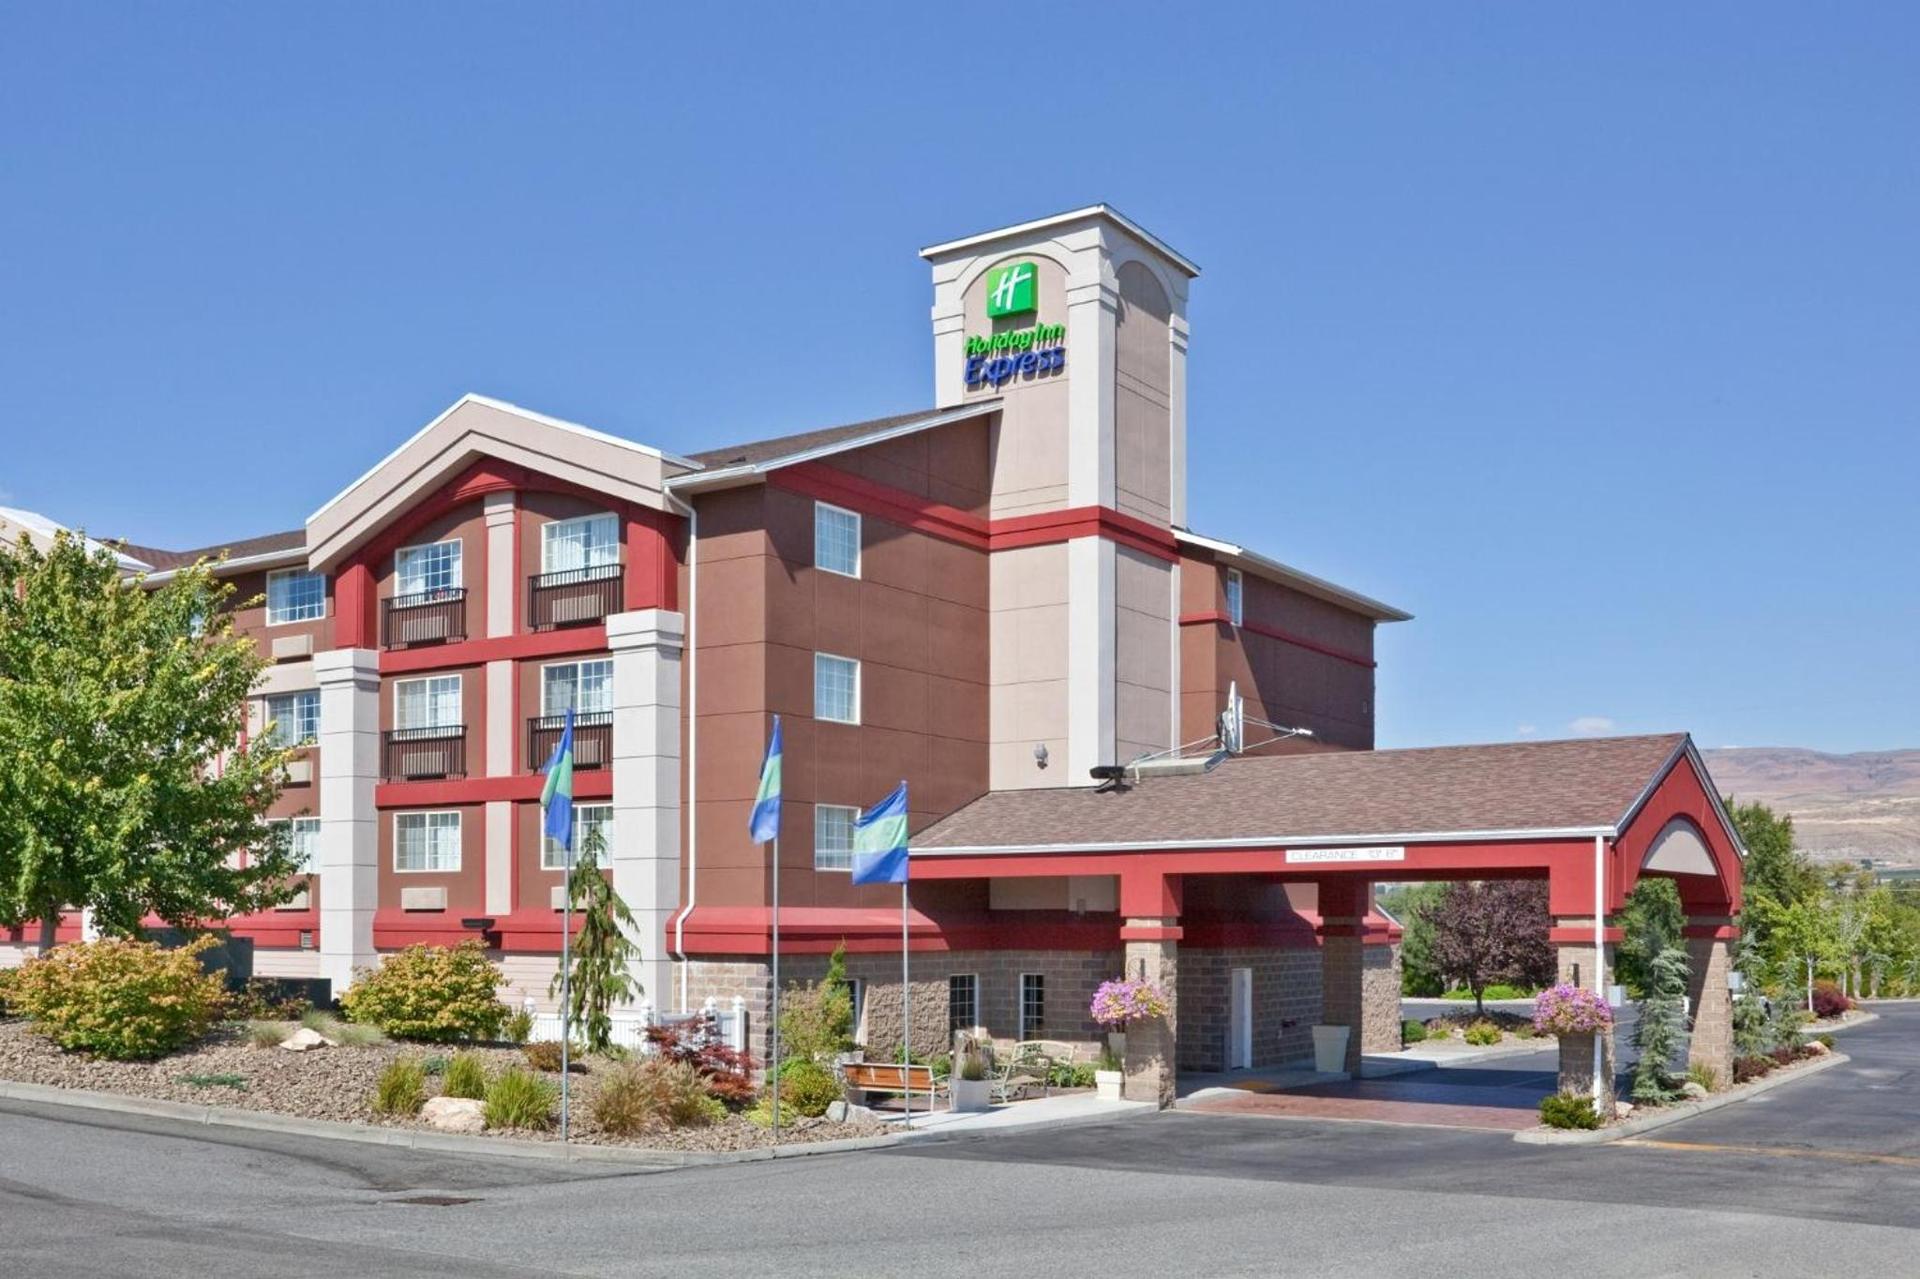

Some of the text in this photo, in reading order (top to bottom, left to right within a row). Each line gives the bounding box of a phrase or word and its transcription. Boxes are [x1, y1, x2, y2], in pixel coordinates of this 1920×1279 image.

[964, 322, 1065, 356] Holiday Inn
[964, 346, 1066, 388] Express
[1291, 850, 1358, 860] CLEARANCE
